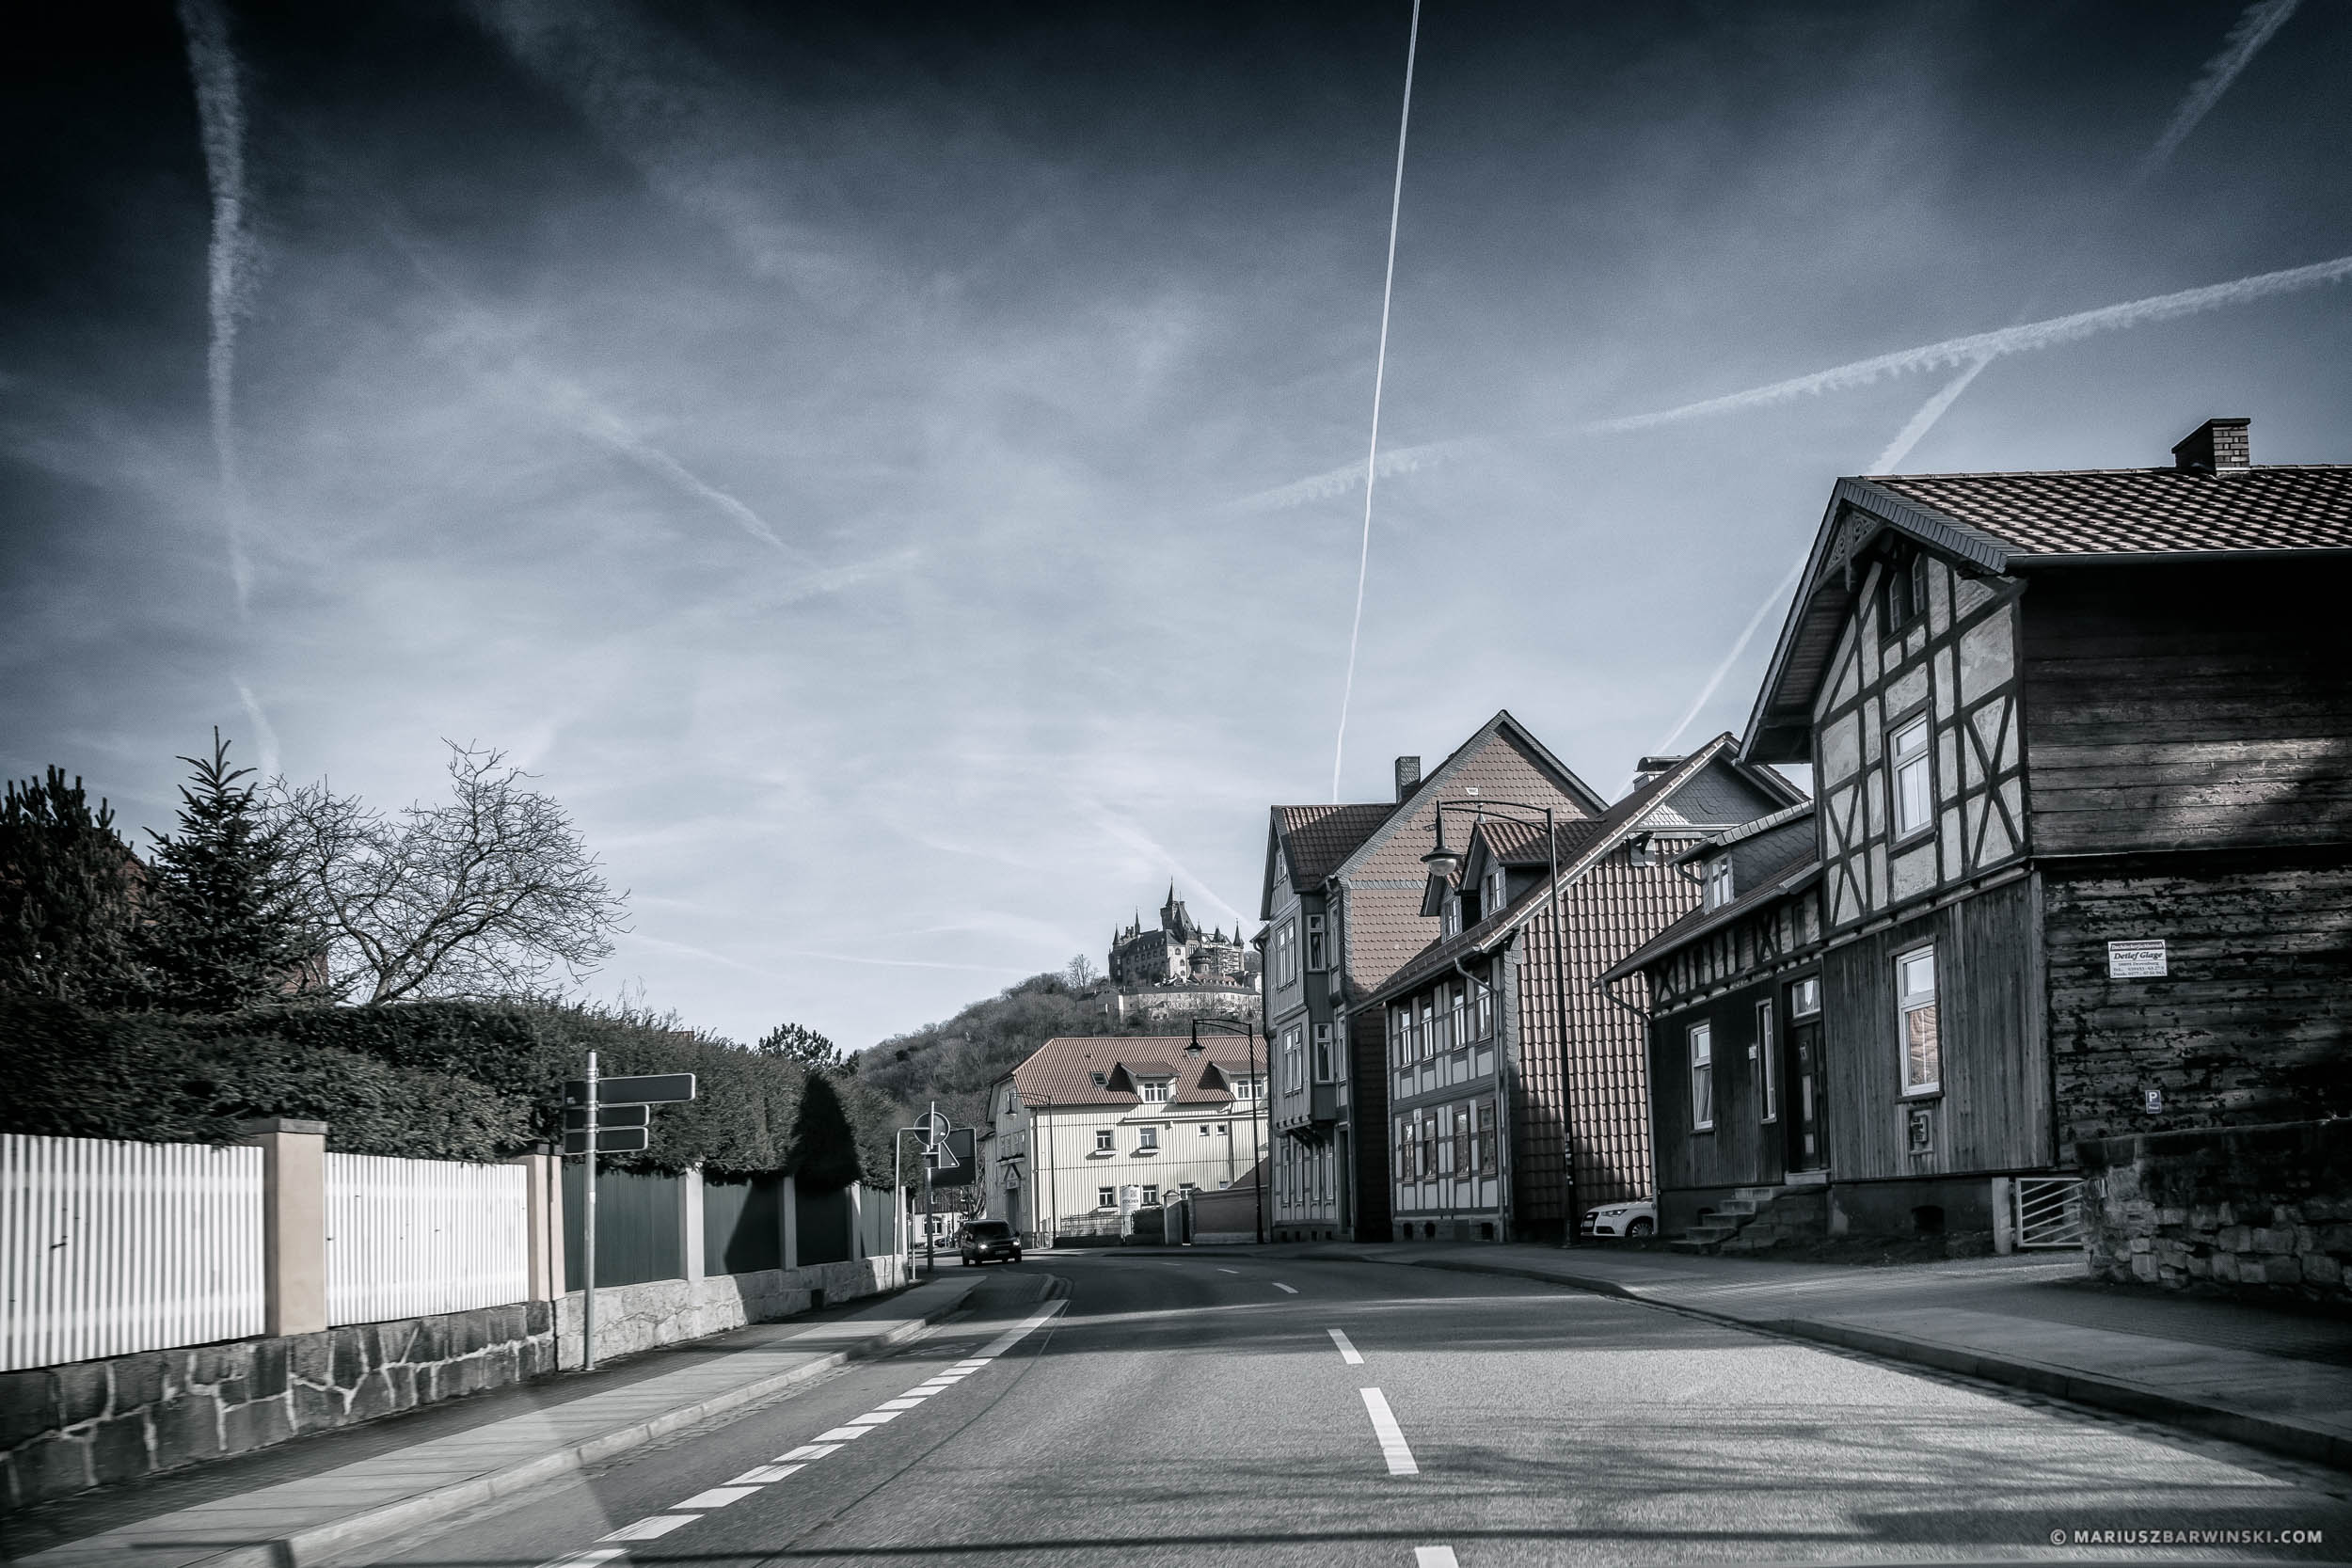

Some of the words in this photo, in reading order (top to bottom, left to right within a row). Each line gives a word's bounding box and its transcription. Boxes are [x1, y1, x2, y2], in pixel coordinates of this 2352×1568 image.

[2114, 952, 2138, 960] Detlef
[2139, 951, 2163, 959] Glage
[2149, 1091, 2157, 1101] P
